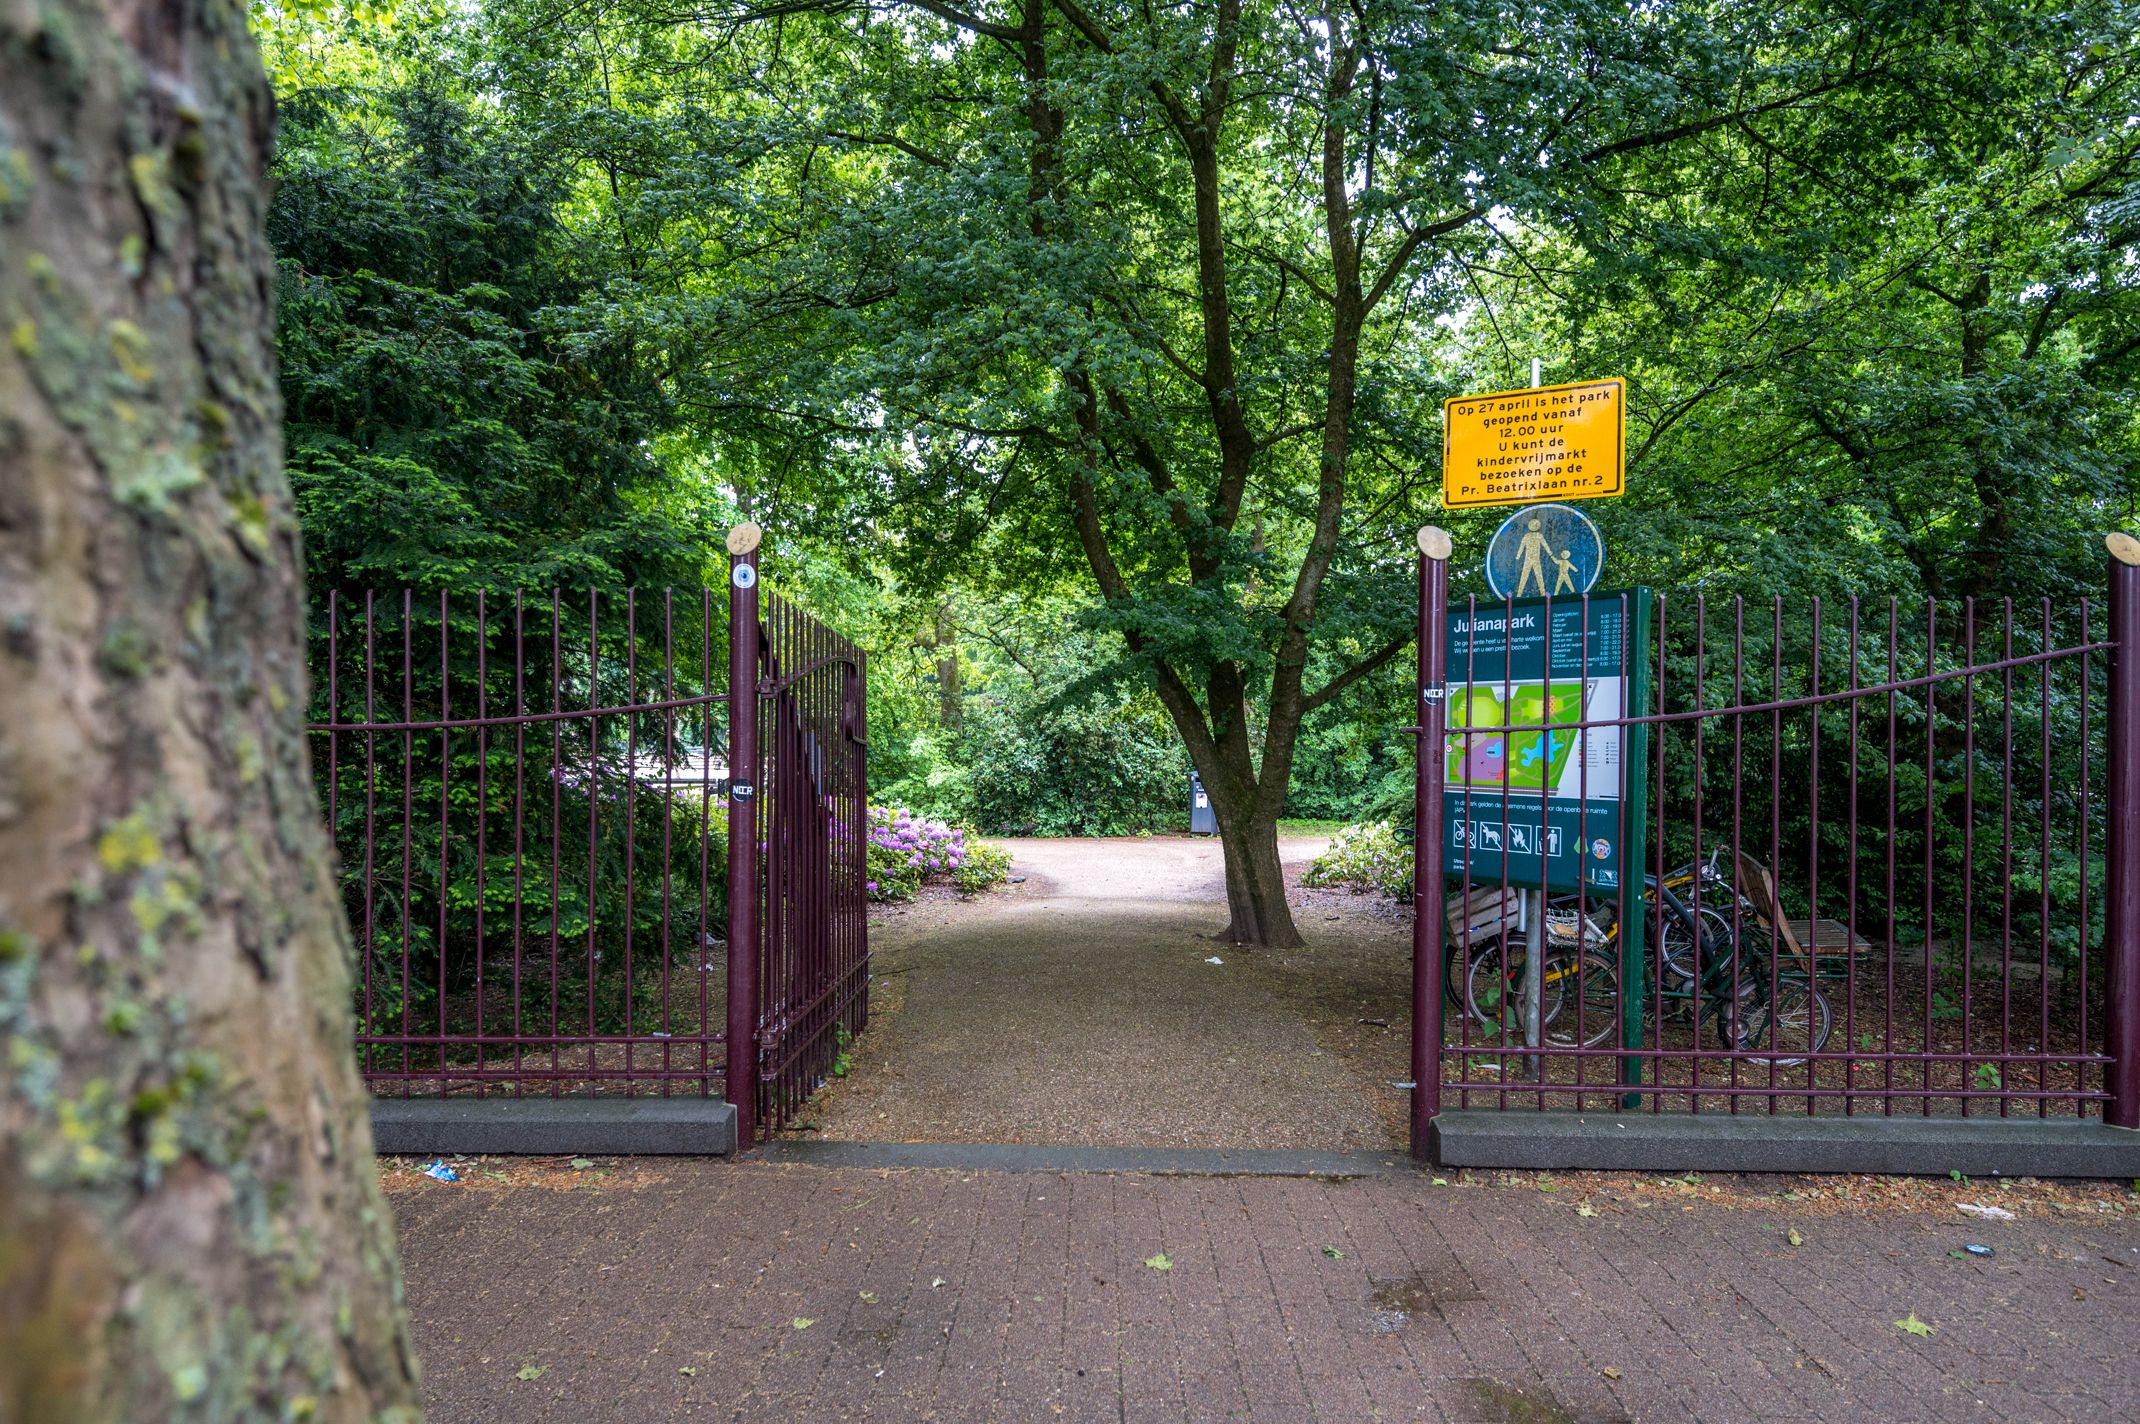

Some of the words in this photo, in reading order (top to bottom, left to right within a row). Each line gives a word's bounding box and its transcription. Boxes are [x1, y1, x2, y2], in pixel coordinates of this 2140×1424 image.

[1458, 406, 1474, 416] Op
[1479, 403, 1494, 413] 27
[1499, 399, 1530, 412] april
[1535, 397, 1546, 407] is
[1552, 394, 1573, 405] het
[1579, 390, 1610, 403] park
[1483, 411, 1538, 429] geopend
[1544, 407, 1582, 420] vanaf
[1500, 426, 1535, 438] 12.00
[1540, 425, 1564, 434] uur
[1499, 443, 1507, 451] U
[1513, 439, 1544, 450] kunt
[1549, 437, 1564, 447] de
[1477, 449, 1587, 467] kindervrijmarkt
[1480, 466, 1542, 481] bezoeken
[1547, 468, 1562, 477] op
[1567, 464, 1583, 473] de
[1461, 486, 1480, 496] Pr.
[1487, 477, 1567, 494] Beatrixlaan
[1454, 613, 1535, 633] Juianapark
[1462, 638, 1485, 647] geente
